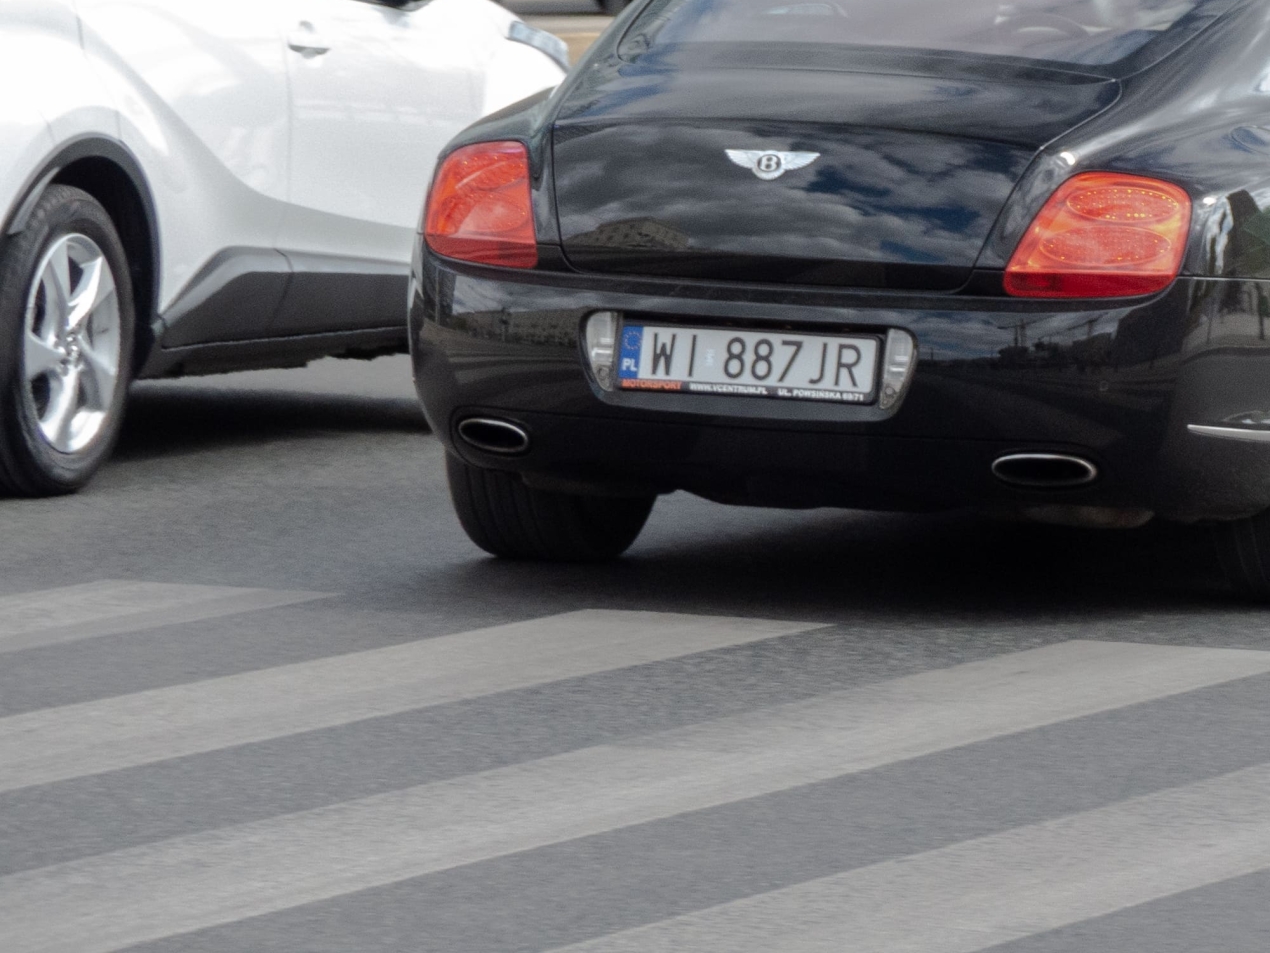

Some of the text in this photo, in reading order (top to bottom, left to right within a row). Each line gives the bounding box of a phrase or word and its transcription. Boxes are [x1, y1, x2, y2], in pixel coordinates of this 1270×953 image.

[651, 332, 698, 378] WI
[621, 357, 638, 371] PL
[621, 379, 683, 391] MOTORSPORT
